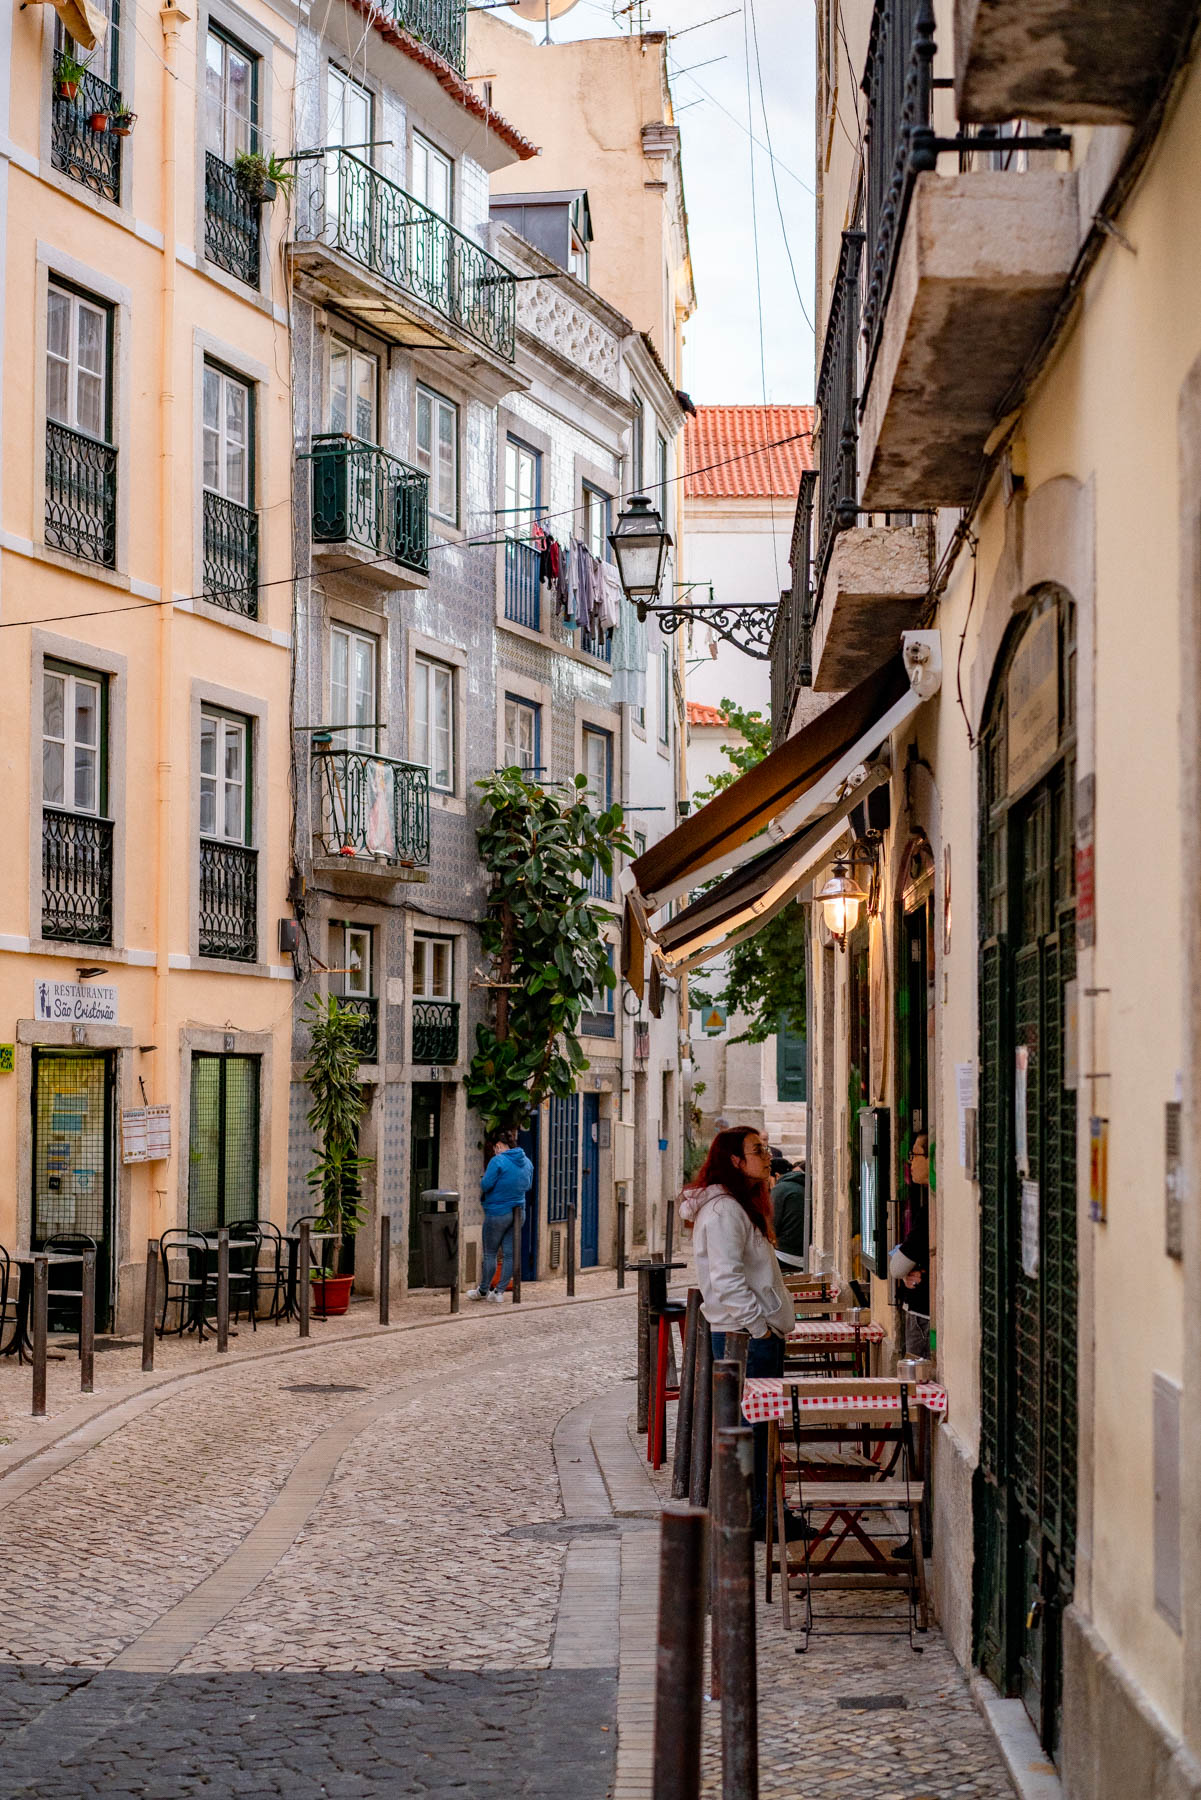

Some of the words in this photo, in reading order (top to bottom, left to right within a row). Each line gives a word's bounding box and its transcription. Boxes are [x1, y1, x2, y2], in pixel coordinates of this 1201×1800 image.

[54, 984, 114, 1000] RESTAURANTE
[54, 998, 72, 1017] São
[74, 1000, 114, 1020] Cristóvão
